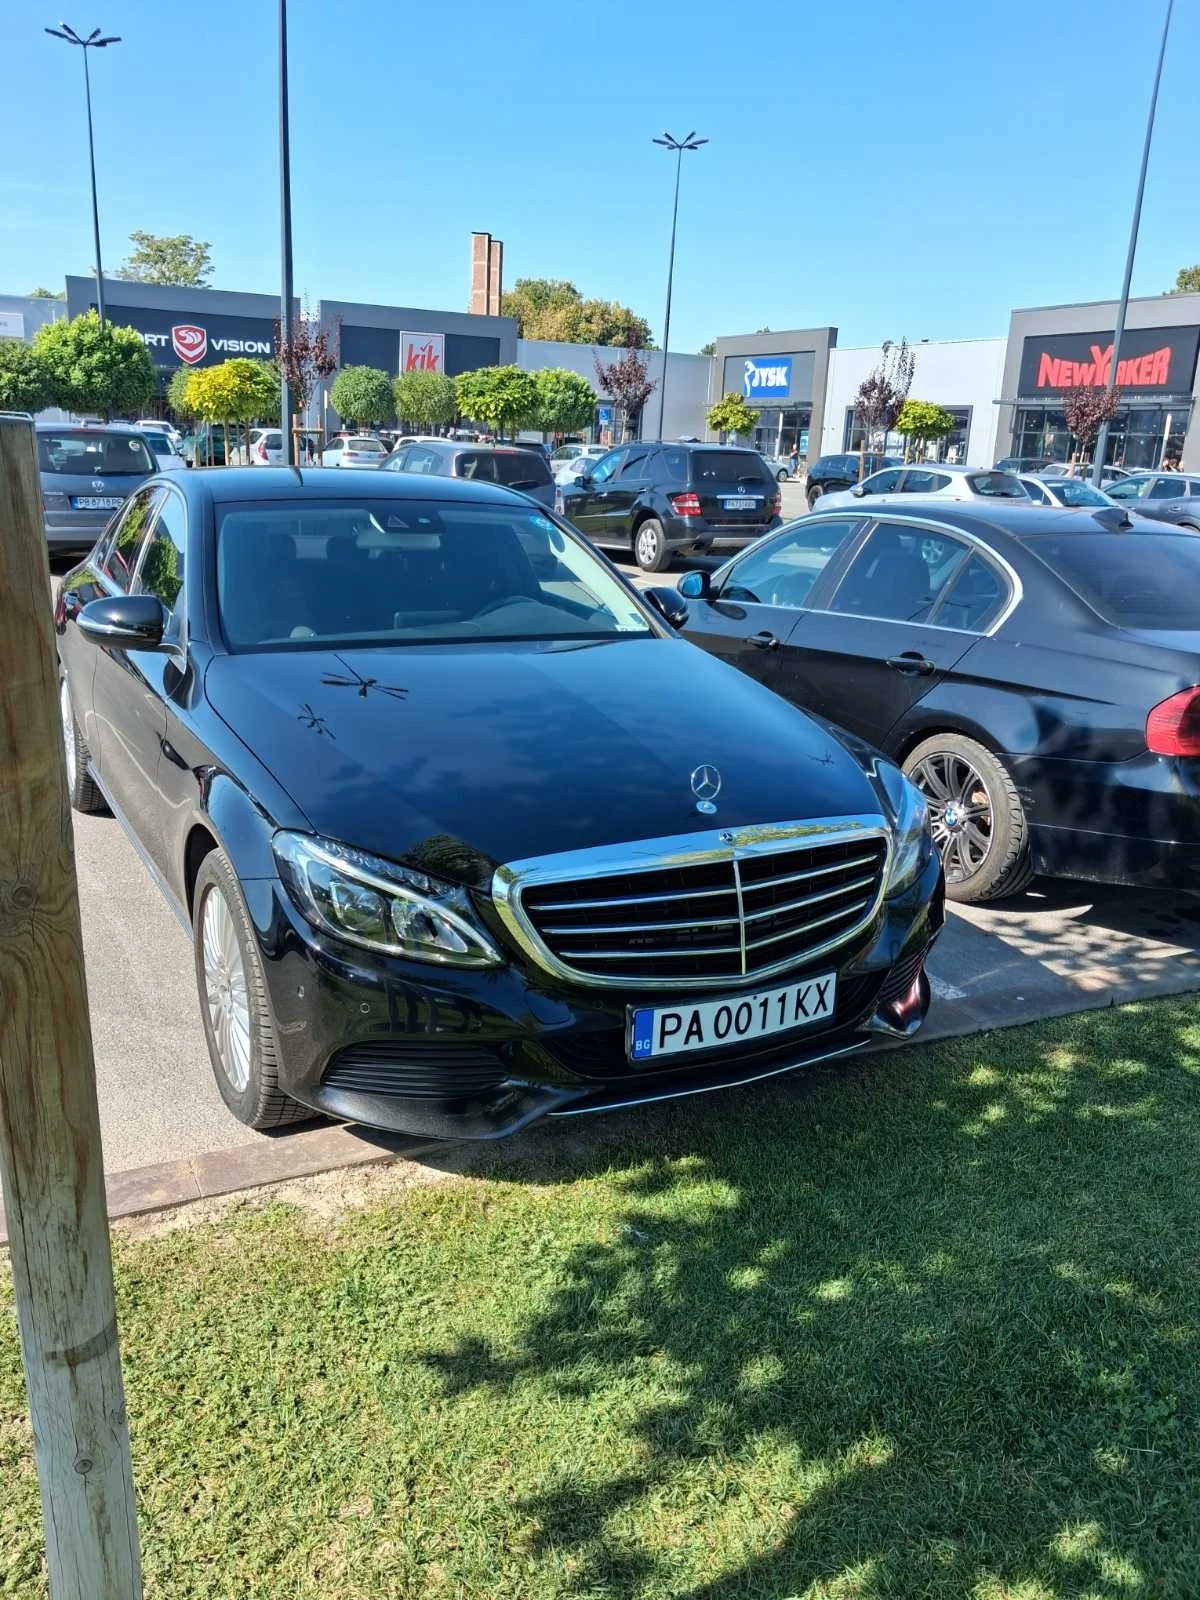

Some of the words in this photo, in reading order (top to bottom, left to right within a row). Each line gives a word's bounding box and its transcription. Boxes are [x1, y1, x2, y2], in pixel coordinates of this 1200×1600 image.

[211, 338, 271, 354] VISION
[751, 366, 788, 388] JYSK
[635, 1039, 651, 1051] BG
